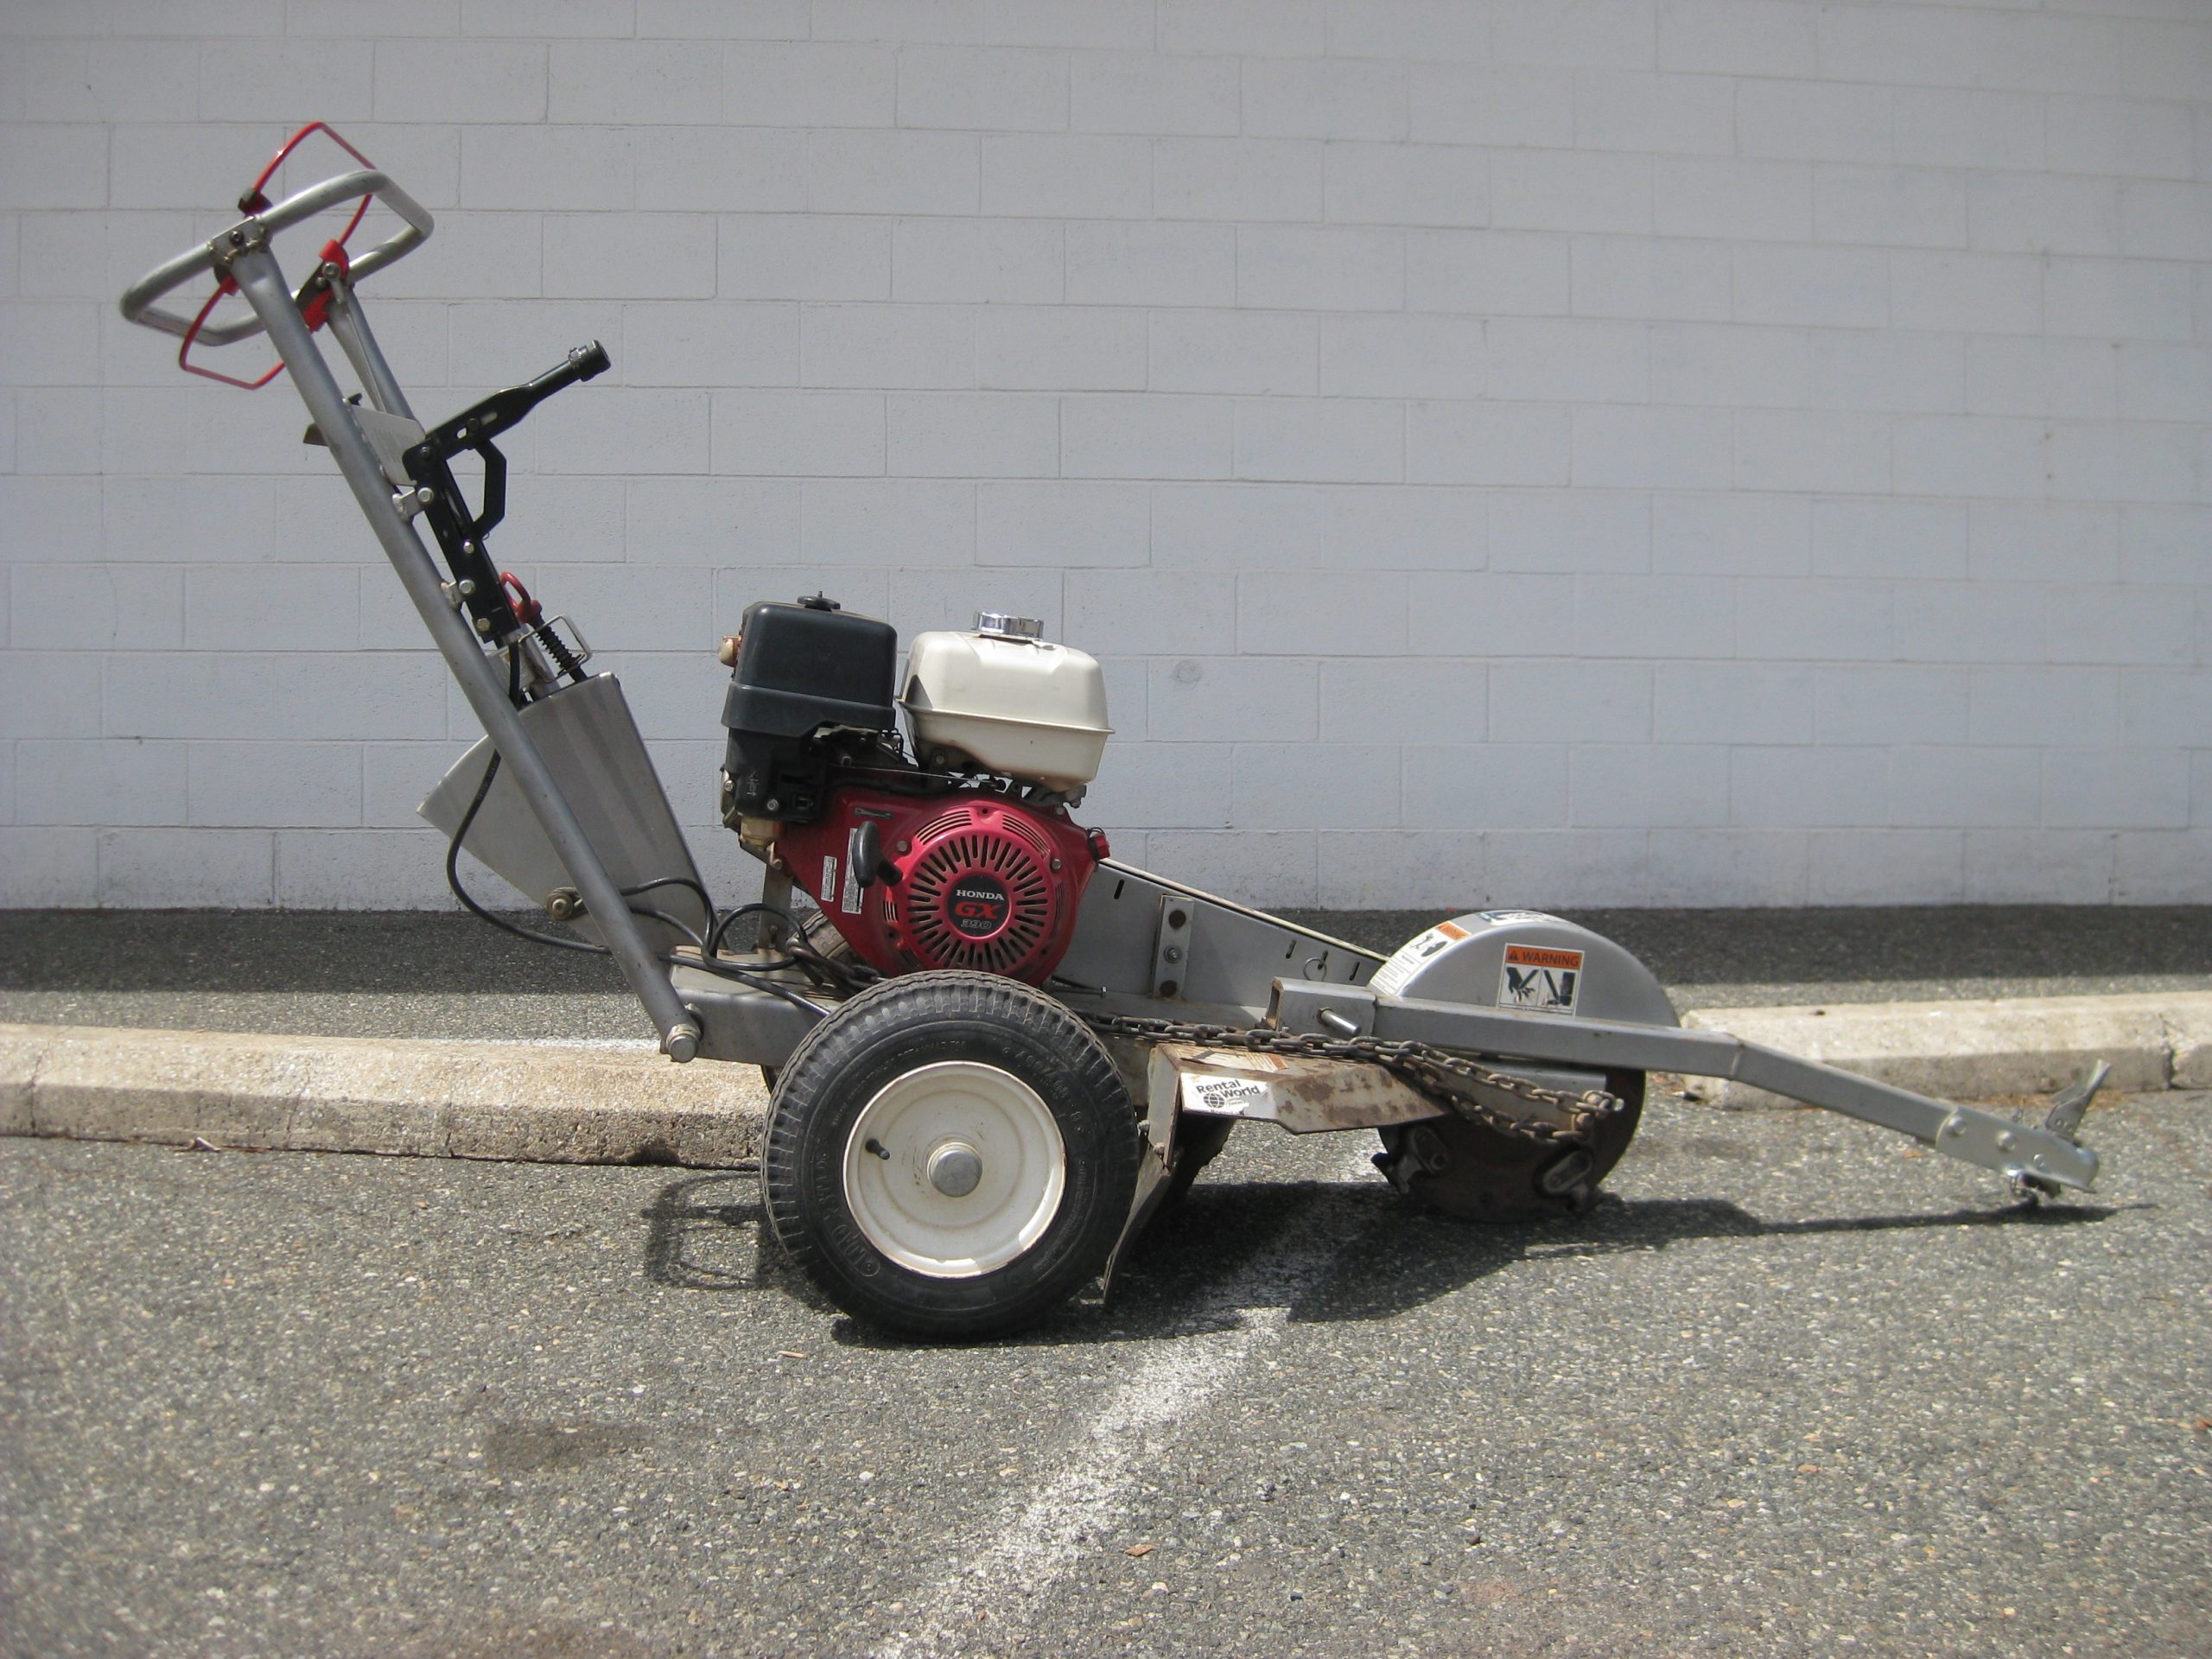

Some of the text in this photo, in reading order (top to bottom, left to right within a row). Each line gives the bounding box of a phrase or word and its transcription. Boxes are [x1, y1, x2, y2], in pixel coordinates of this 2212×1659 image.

[956, 889, 1005, 900] HONDA
[954, 901, 1002, 919] GX
[1522, 950, 1580, 967] WARNING
[1196, 1079, 1242, 1094] Rental
[1220, 1085, 1261, 1098] World
